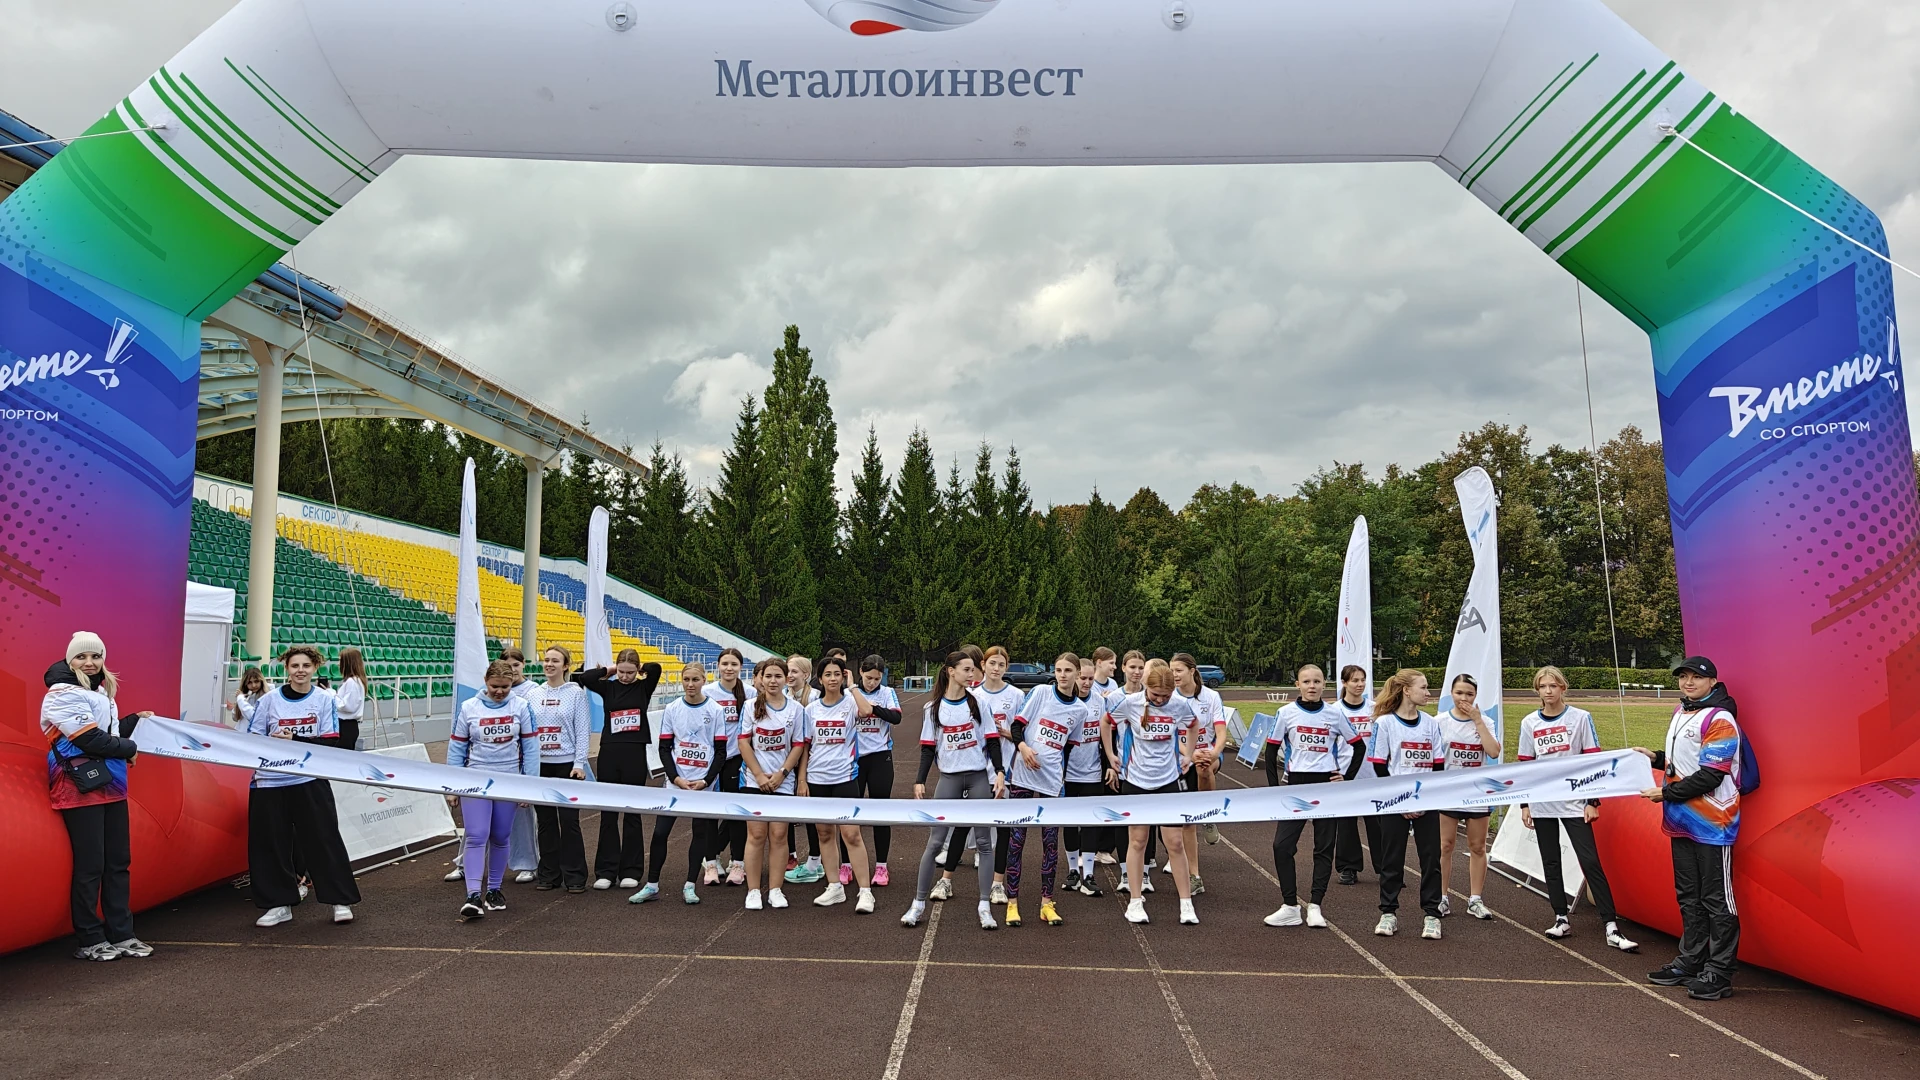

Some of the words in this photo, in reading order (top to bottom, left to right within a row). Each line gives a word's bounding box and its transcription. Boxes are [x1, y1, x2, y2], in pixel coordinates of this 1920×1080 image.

[714, 58, 1083, 99] Металлоинвест
[1760, 427, 1786, 440] СО
[1791, 421, 1871, 438] СПОРТОМ
[302, 504, 337, 523] СЕКТОР
[482, 545, 501, 557] СЕКТОР
[614, 715, 638, 726] 0675
[483, 724, 511, 736] 0658
[818, 728, 842, 737] 0674
[1040, 727, 1063, 742] 0651
[1081, 727, 1098, 736] 624
[1144, 724, 1170, 733] 0659
[539, 733, 558, 742] 676
[758, 735, 782, 745] 0650
[946, 730, 973, 743] 0646
[1300, 733, 1326, 745] 0634
[1537, 734, 1564, 747] 0663
[257, 750, 312, 768] Вместе!
[1405, 749, 1431, 760] 0690
[1454, 749, 1479, 760] 0660
[1565, 757, 1619, 791] Вместе!
[1371, 780, 1422, 812] Вместе!
[1461, 793, 1531, 806] Металлоинвест
[360, 804, 414, 826] Металлоинвест
[1180, 797, 1231, 822] Вместе!
